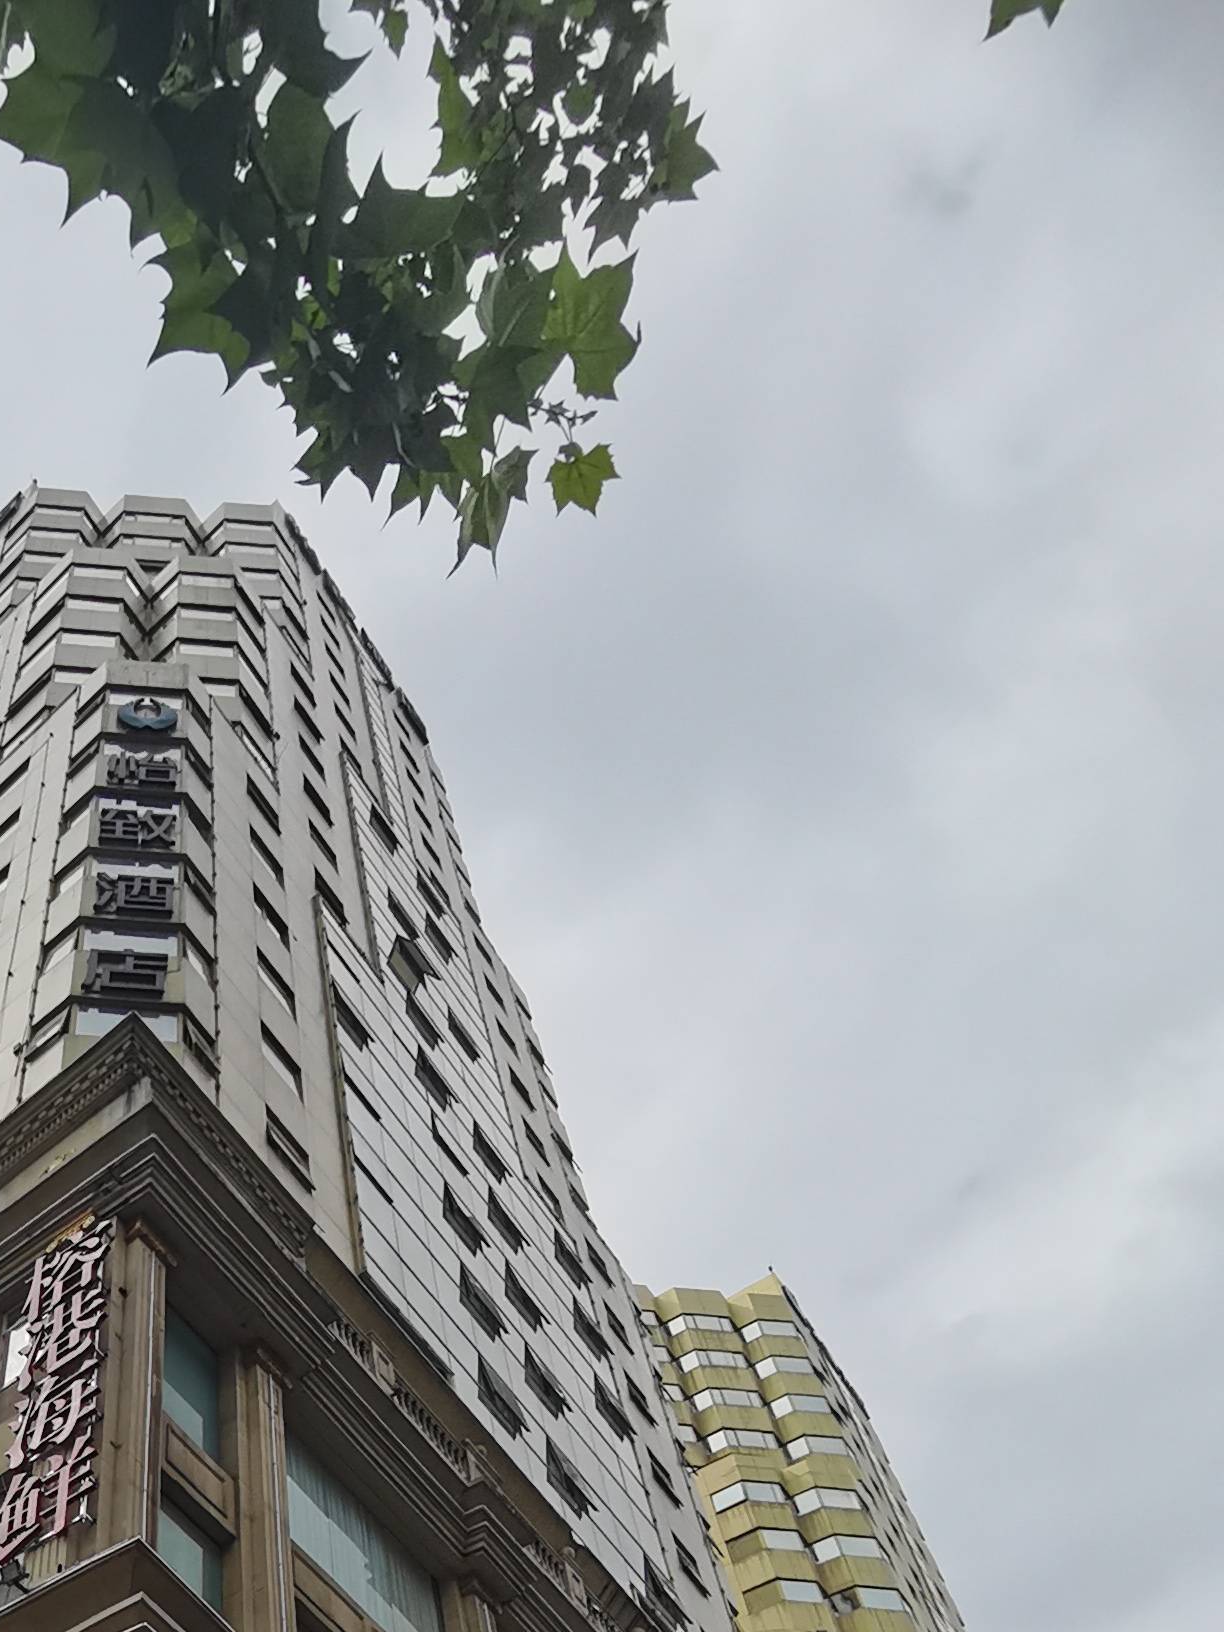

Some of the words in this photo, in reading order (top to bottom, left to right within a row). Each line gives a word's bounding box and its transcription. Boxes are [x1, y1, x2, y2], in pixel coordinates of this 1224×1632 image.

[81, 751, 177, 998] 怡致酒店
[0, 1218, 114, 1564] 榕港海鲜
